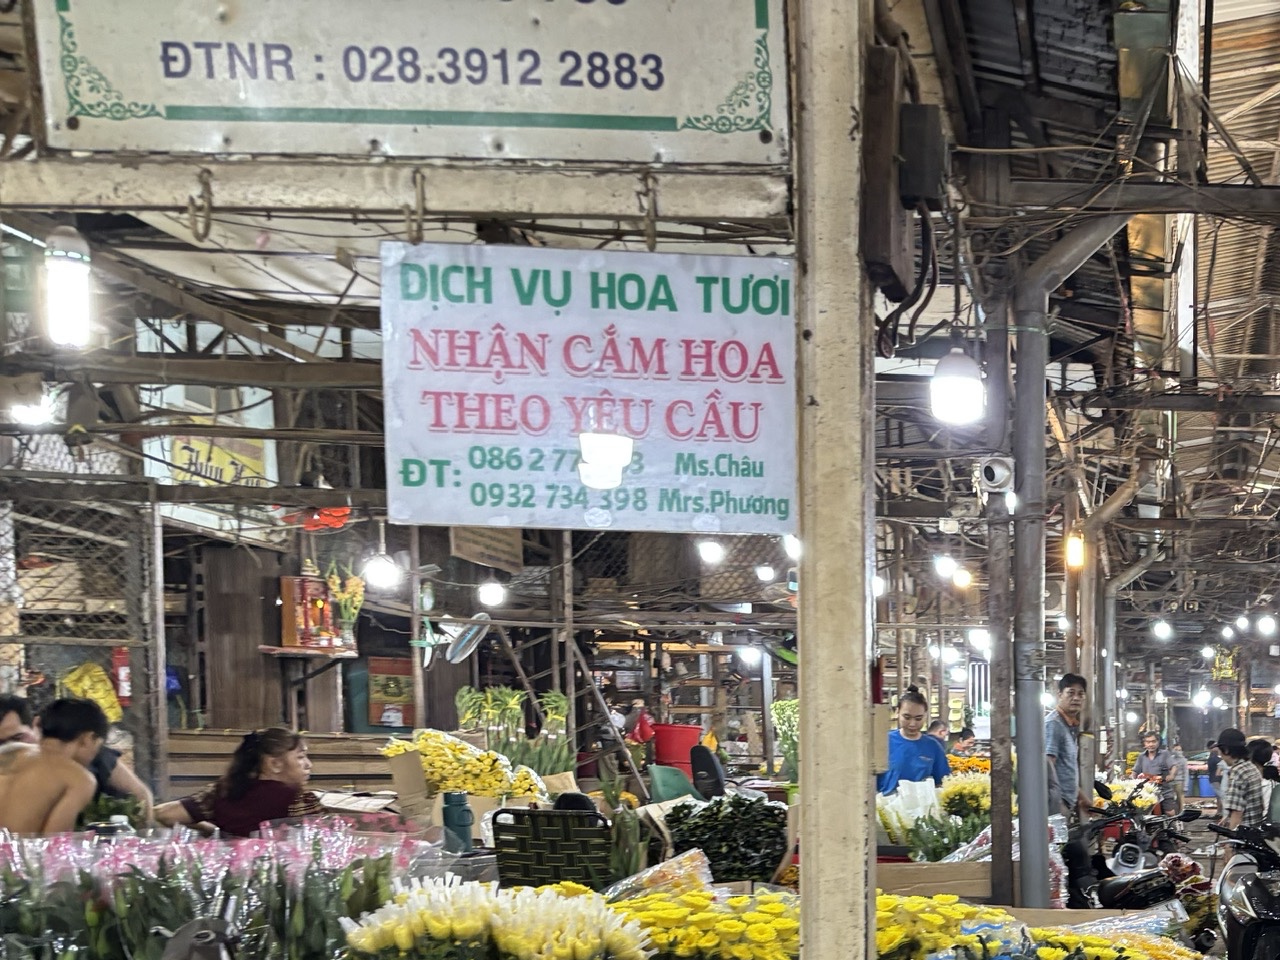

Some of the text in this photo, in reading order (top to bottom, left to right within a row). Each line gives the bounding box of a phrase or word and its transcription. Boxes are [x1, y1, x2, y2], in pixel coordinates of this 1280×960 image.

[161, 41, 295, 81] ĐTNR
[343, 45, 542, 85] 028.3912
[559, 50, 665, 91] 2883
[400, 262, 790, 316] DỊCH VỤ HOA TƯƠI
[409, 322, 785, 383] NHẬN CẮM HOA
[422, 389, 763, 442] THEO YÊU CẦU
[399, 458, 462, 488] ĐT:
[674, 452, 764, 478] Ms.Châu
[470, 482, 790, 520] 0932 734 398 Mrs.Phương
